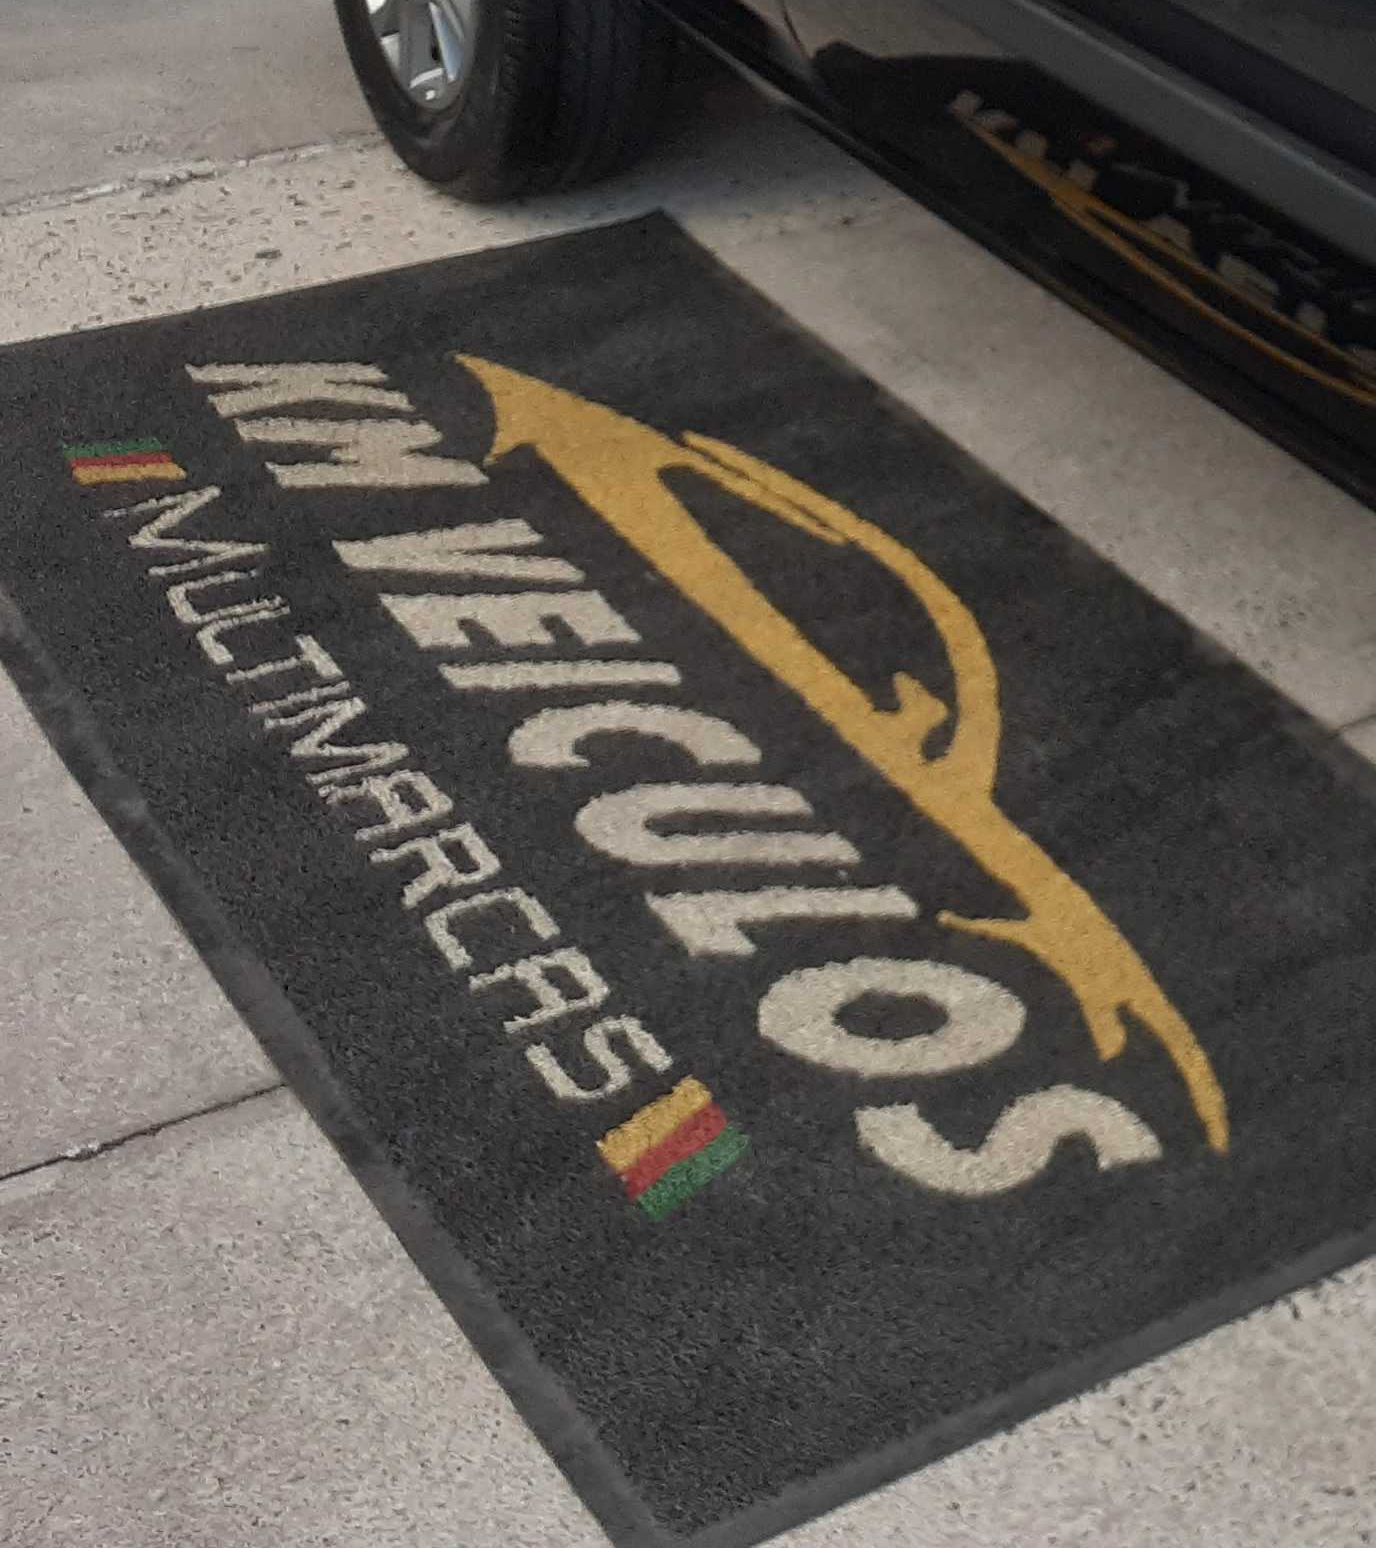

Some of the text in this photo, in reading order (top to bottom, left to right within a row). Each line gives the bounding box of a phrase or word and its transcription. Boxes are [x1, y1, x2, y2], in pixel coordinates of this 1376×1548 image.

[103, 485, 674, 1102] MULTIMARCAS
[184, 360, 1163, 1198] KM VEICULOS
